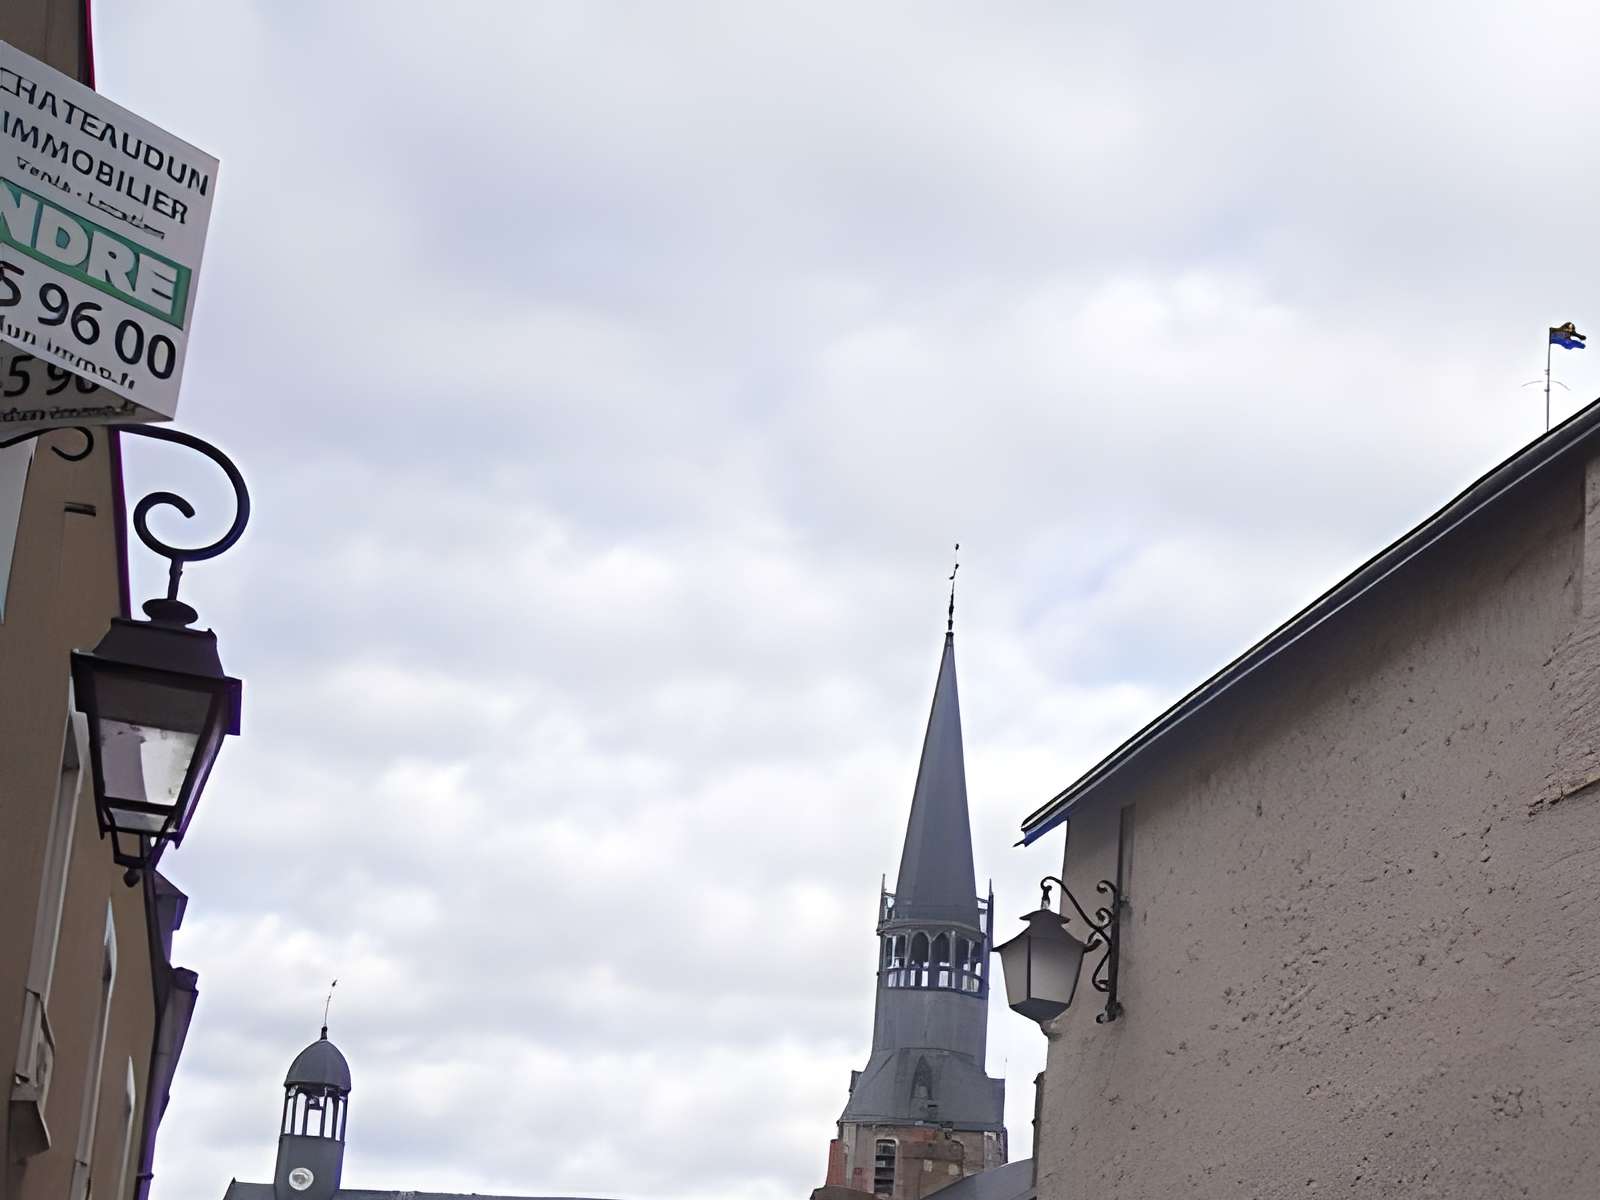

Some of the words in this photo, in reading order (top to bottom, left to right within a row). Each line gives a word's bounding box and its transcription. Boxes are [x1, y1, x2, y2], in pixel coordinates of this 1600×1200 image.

[0, 66, 209, 197] CHATEAUDUN
[3, 110, 189, 225] IMMOBILIER
[37, 282, 103, 346] 96
[114, 318, 177, 380] 00
